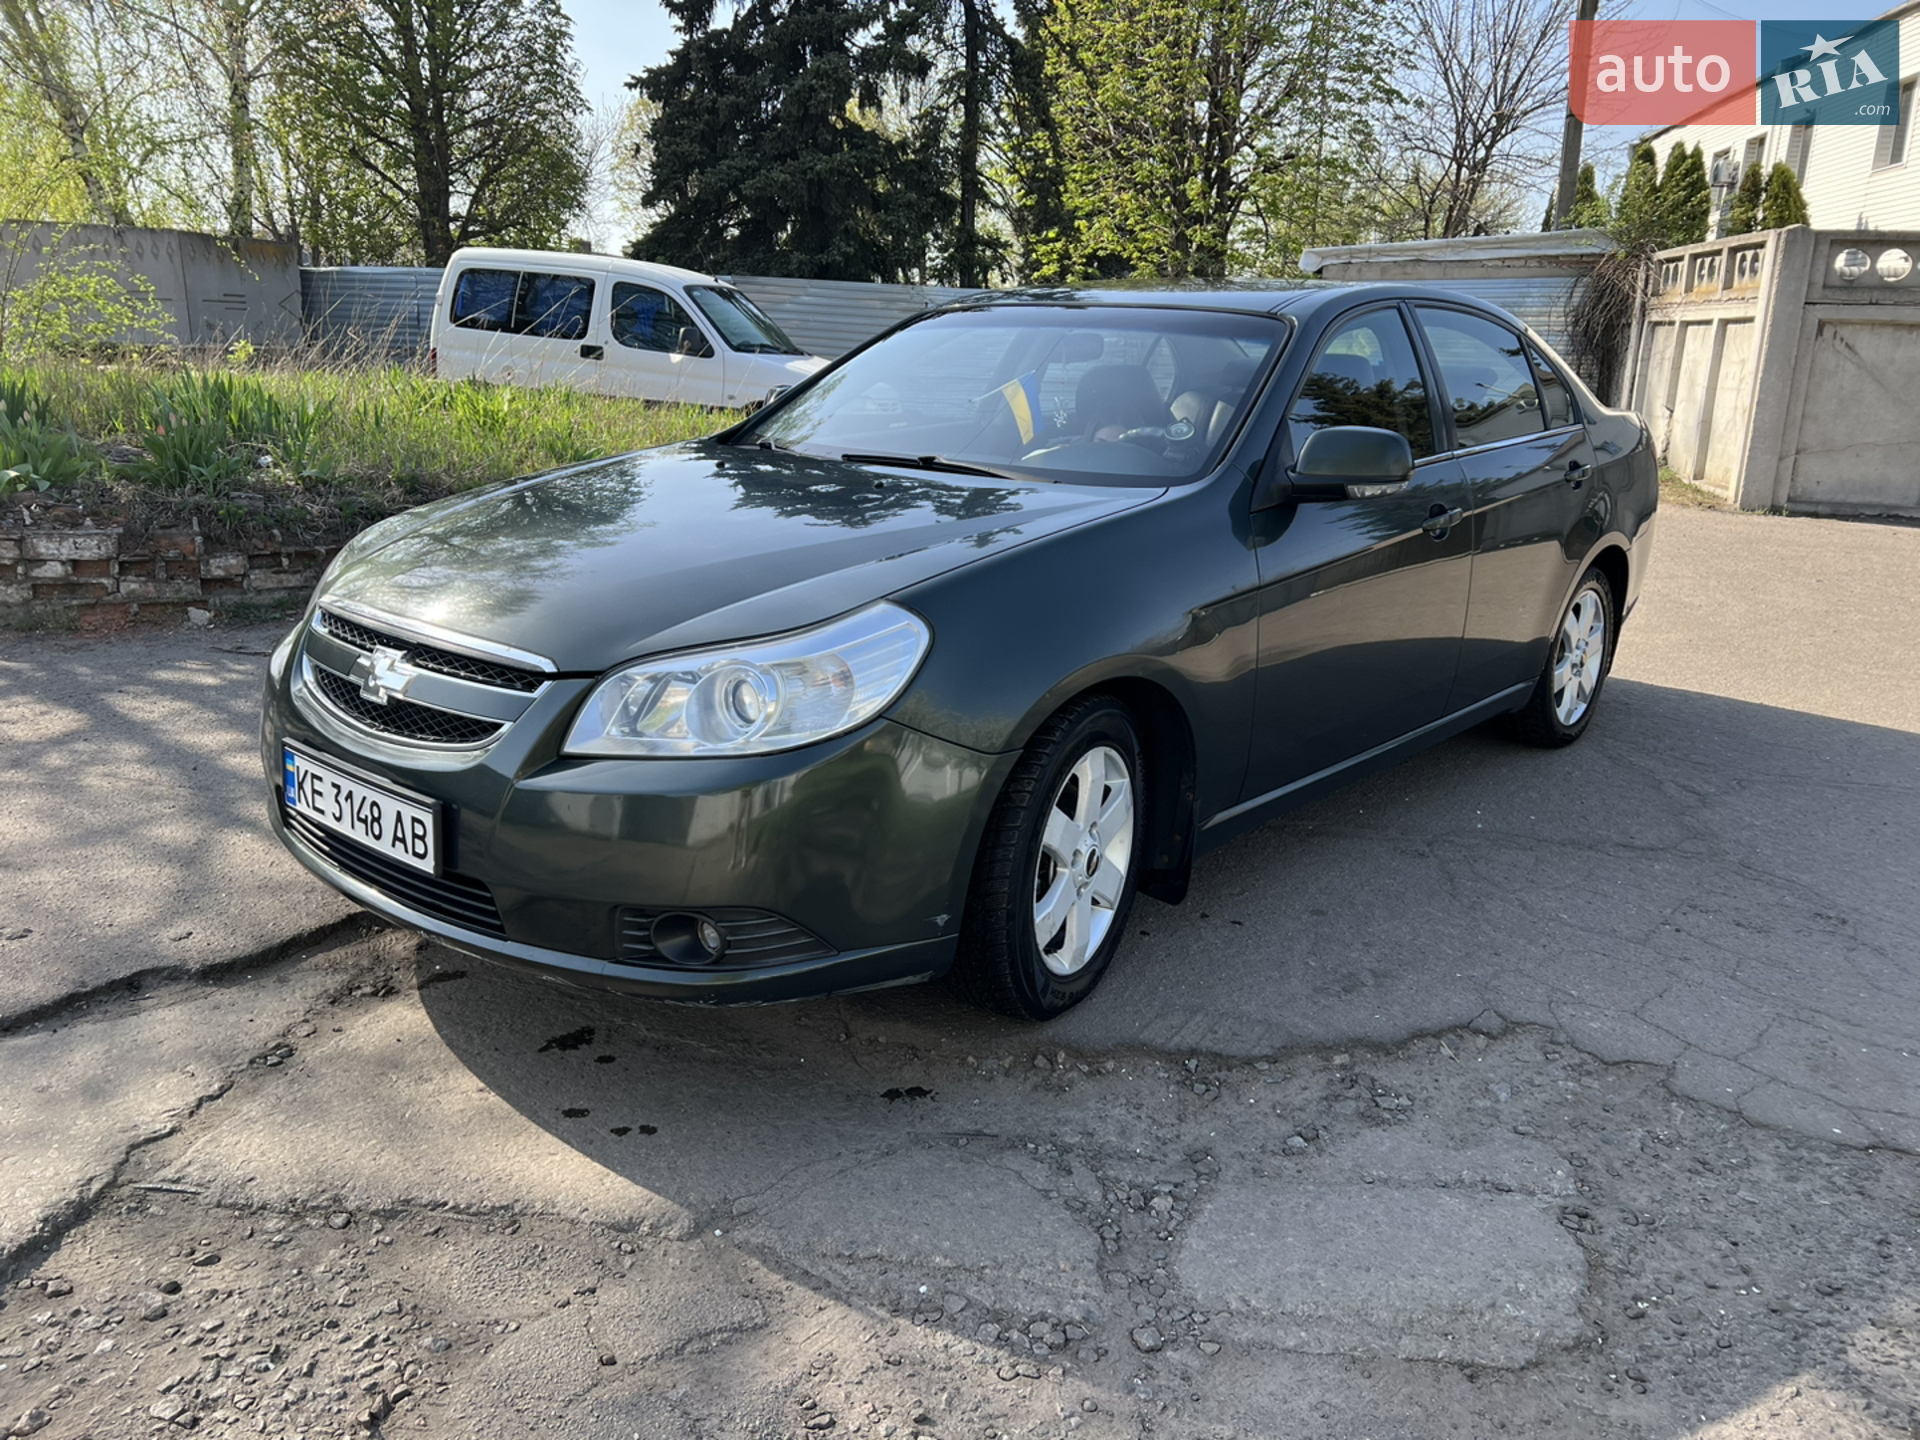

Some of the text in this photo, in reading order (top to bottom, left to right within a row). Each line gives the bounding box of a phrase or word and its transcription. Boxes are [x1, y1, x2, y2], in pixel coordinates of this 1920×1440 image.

[296, 765, 429, 860] KE 3148 AB
